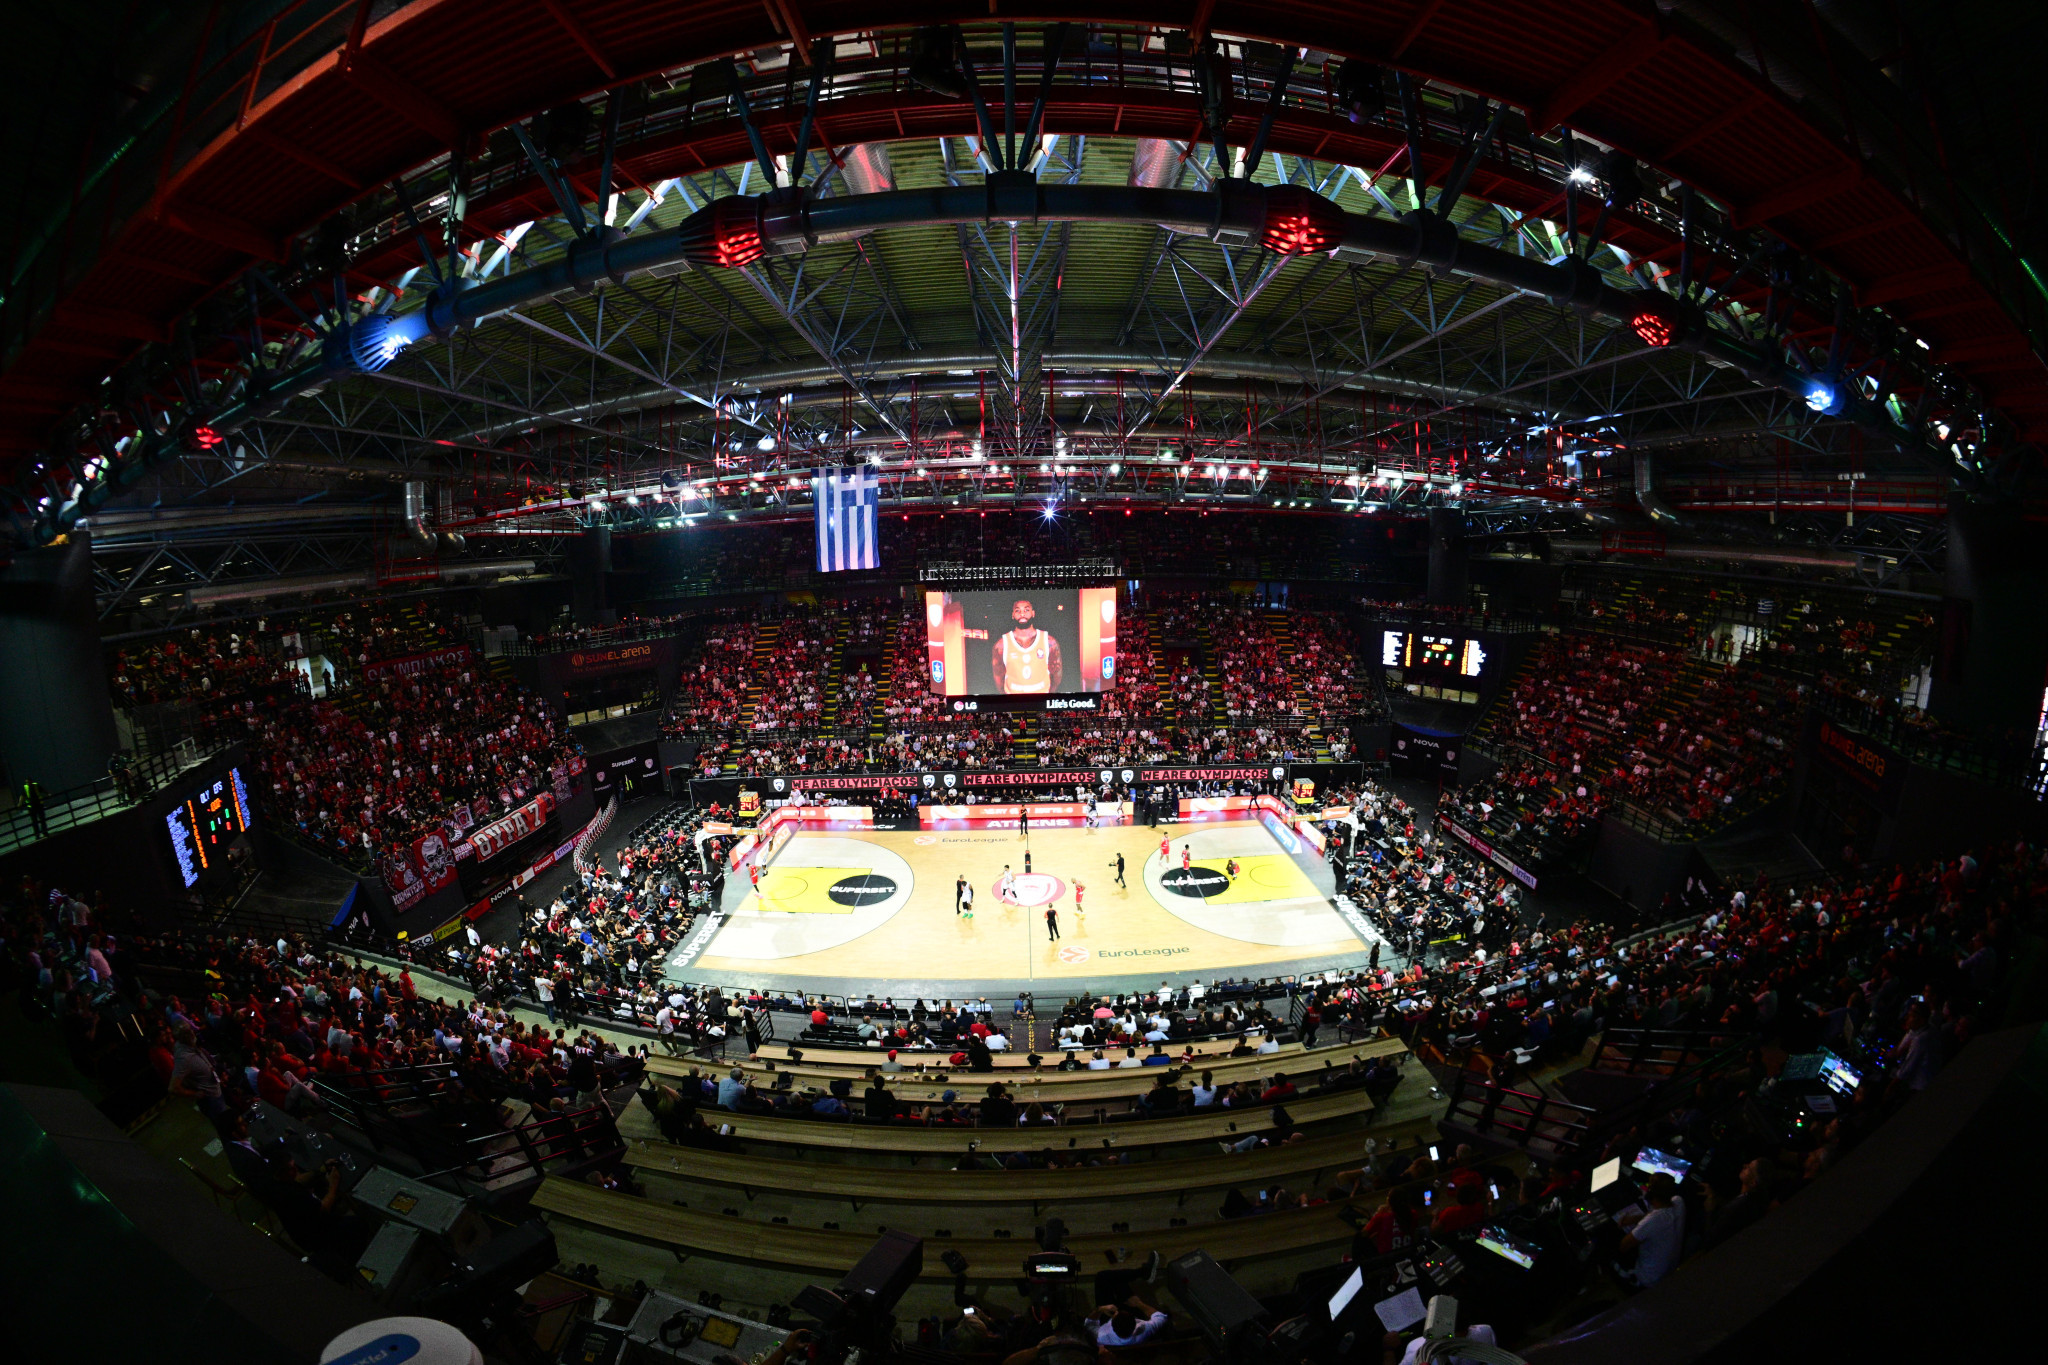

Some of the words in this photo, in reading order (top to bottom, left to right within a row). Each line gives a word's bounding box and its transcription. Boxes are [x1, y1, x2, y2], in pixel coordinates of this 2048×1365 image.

[621, 645, 651, 659] arena
[965, 701, 977, 710] LG
[1046, 699, 1068, 709] Life's
[1068, 698, 1096, 708] Good.
[1413, 738, 1440, 749] NOVA
[611, 756, 637, 768] SUPERBET
[1392, 752, 1409, 760] NOVA
[1440, 763, 1458, 771] NOVA
[964, 775, 982, 785] WE
[985, 774, 1010, 784] ARE
[1013, 772, 1096, 784] OLYMPIACOS
[1142, 770, 1159, 780] WE
[1162, 769, 1187, 780] ARE
[1190, 768, 1268, 780] OLYMPIACOS
[792, 780, 809, 789] WE
[812, 779, 835, 789] ARE
[838, 776, 918, 788] OLYMPIACOS
[1300, 789, 1313, 798] 24
[740, 802, 752, 811] 24
[526, 803, 542, 827] 7
[490, 886, 513, 904] NOVA
[829, 884, 896, 895] SUPERBET
[1333, 894, 1391, 947] SUPERBET
[672, 911, 725, 968] SUPERBET
[1098, 945, 1190, 958] EuroLeague
